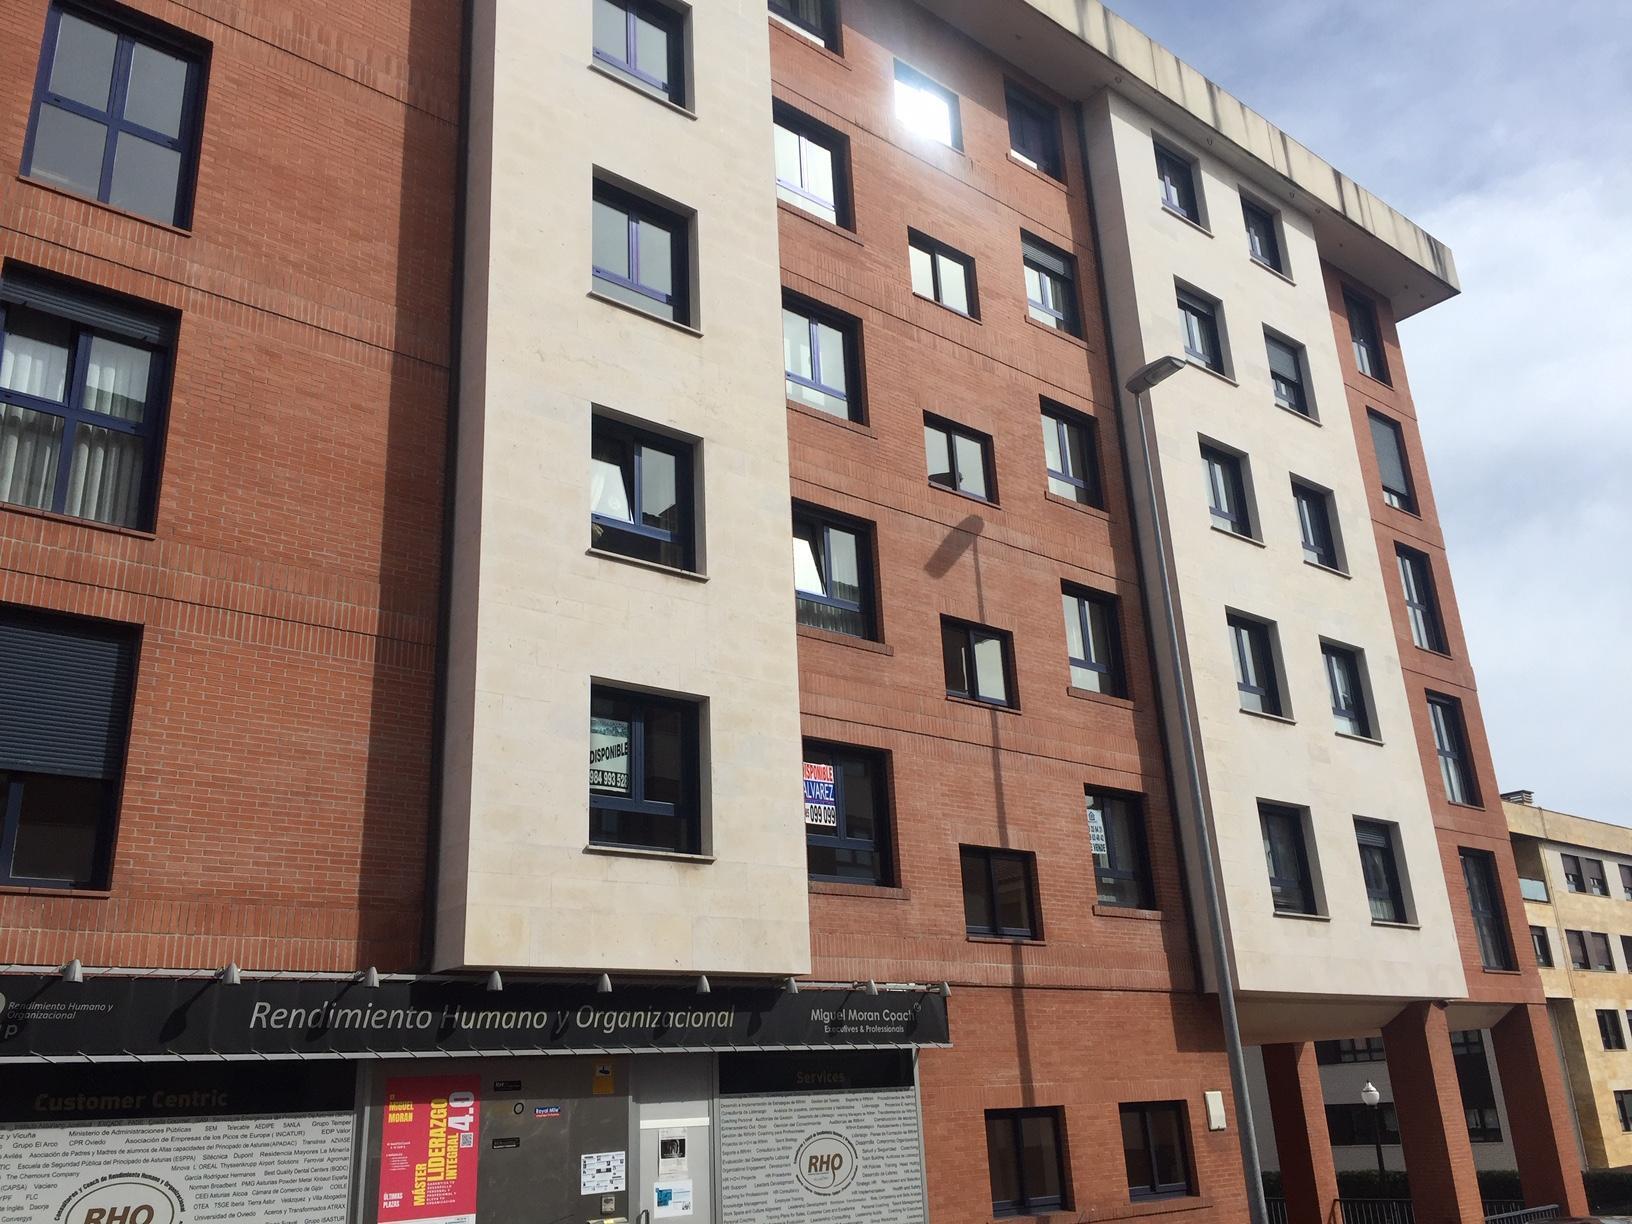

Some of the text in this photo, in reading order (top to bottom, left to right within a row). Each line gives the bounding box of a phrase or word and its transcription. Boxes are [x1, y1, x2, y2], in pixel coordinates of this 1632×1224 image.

[590, 742, 628, 764] DISPONIBLE
[590, 770, 602, 784] 984
[604, 772, 616, 786] 993
[804, 764, 832, 782] ISPONIBLE
[8, 1002, 114, 1012] Rendimiento Humano y
[8, 1010, 76, 1020] Organizacional
[249, 1000, 735, 1034] Rendimiento Humano y Organizacional
[810, 1008, 914, 1024] Miguel Moran Coach
[866, 1025, 904, 1033] Professionals
[796, 1071, 846, 1084] Services
[33, 1089, 228, 1111] Customer Centric
[448, 1092, 474, 1131] 4.0
[112, 1127, 164, 1135] Administraciones
[216, 1142, 242, 1150] Principado
[427, 1098, 448, 1182] LIDERAZGO
[446, 1132, 459, 1180] INTEGRAL
[412, 1163, 427, 1206] MÁSTER
